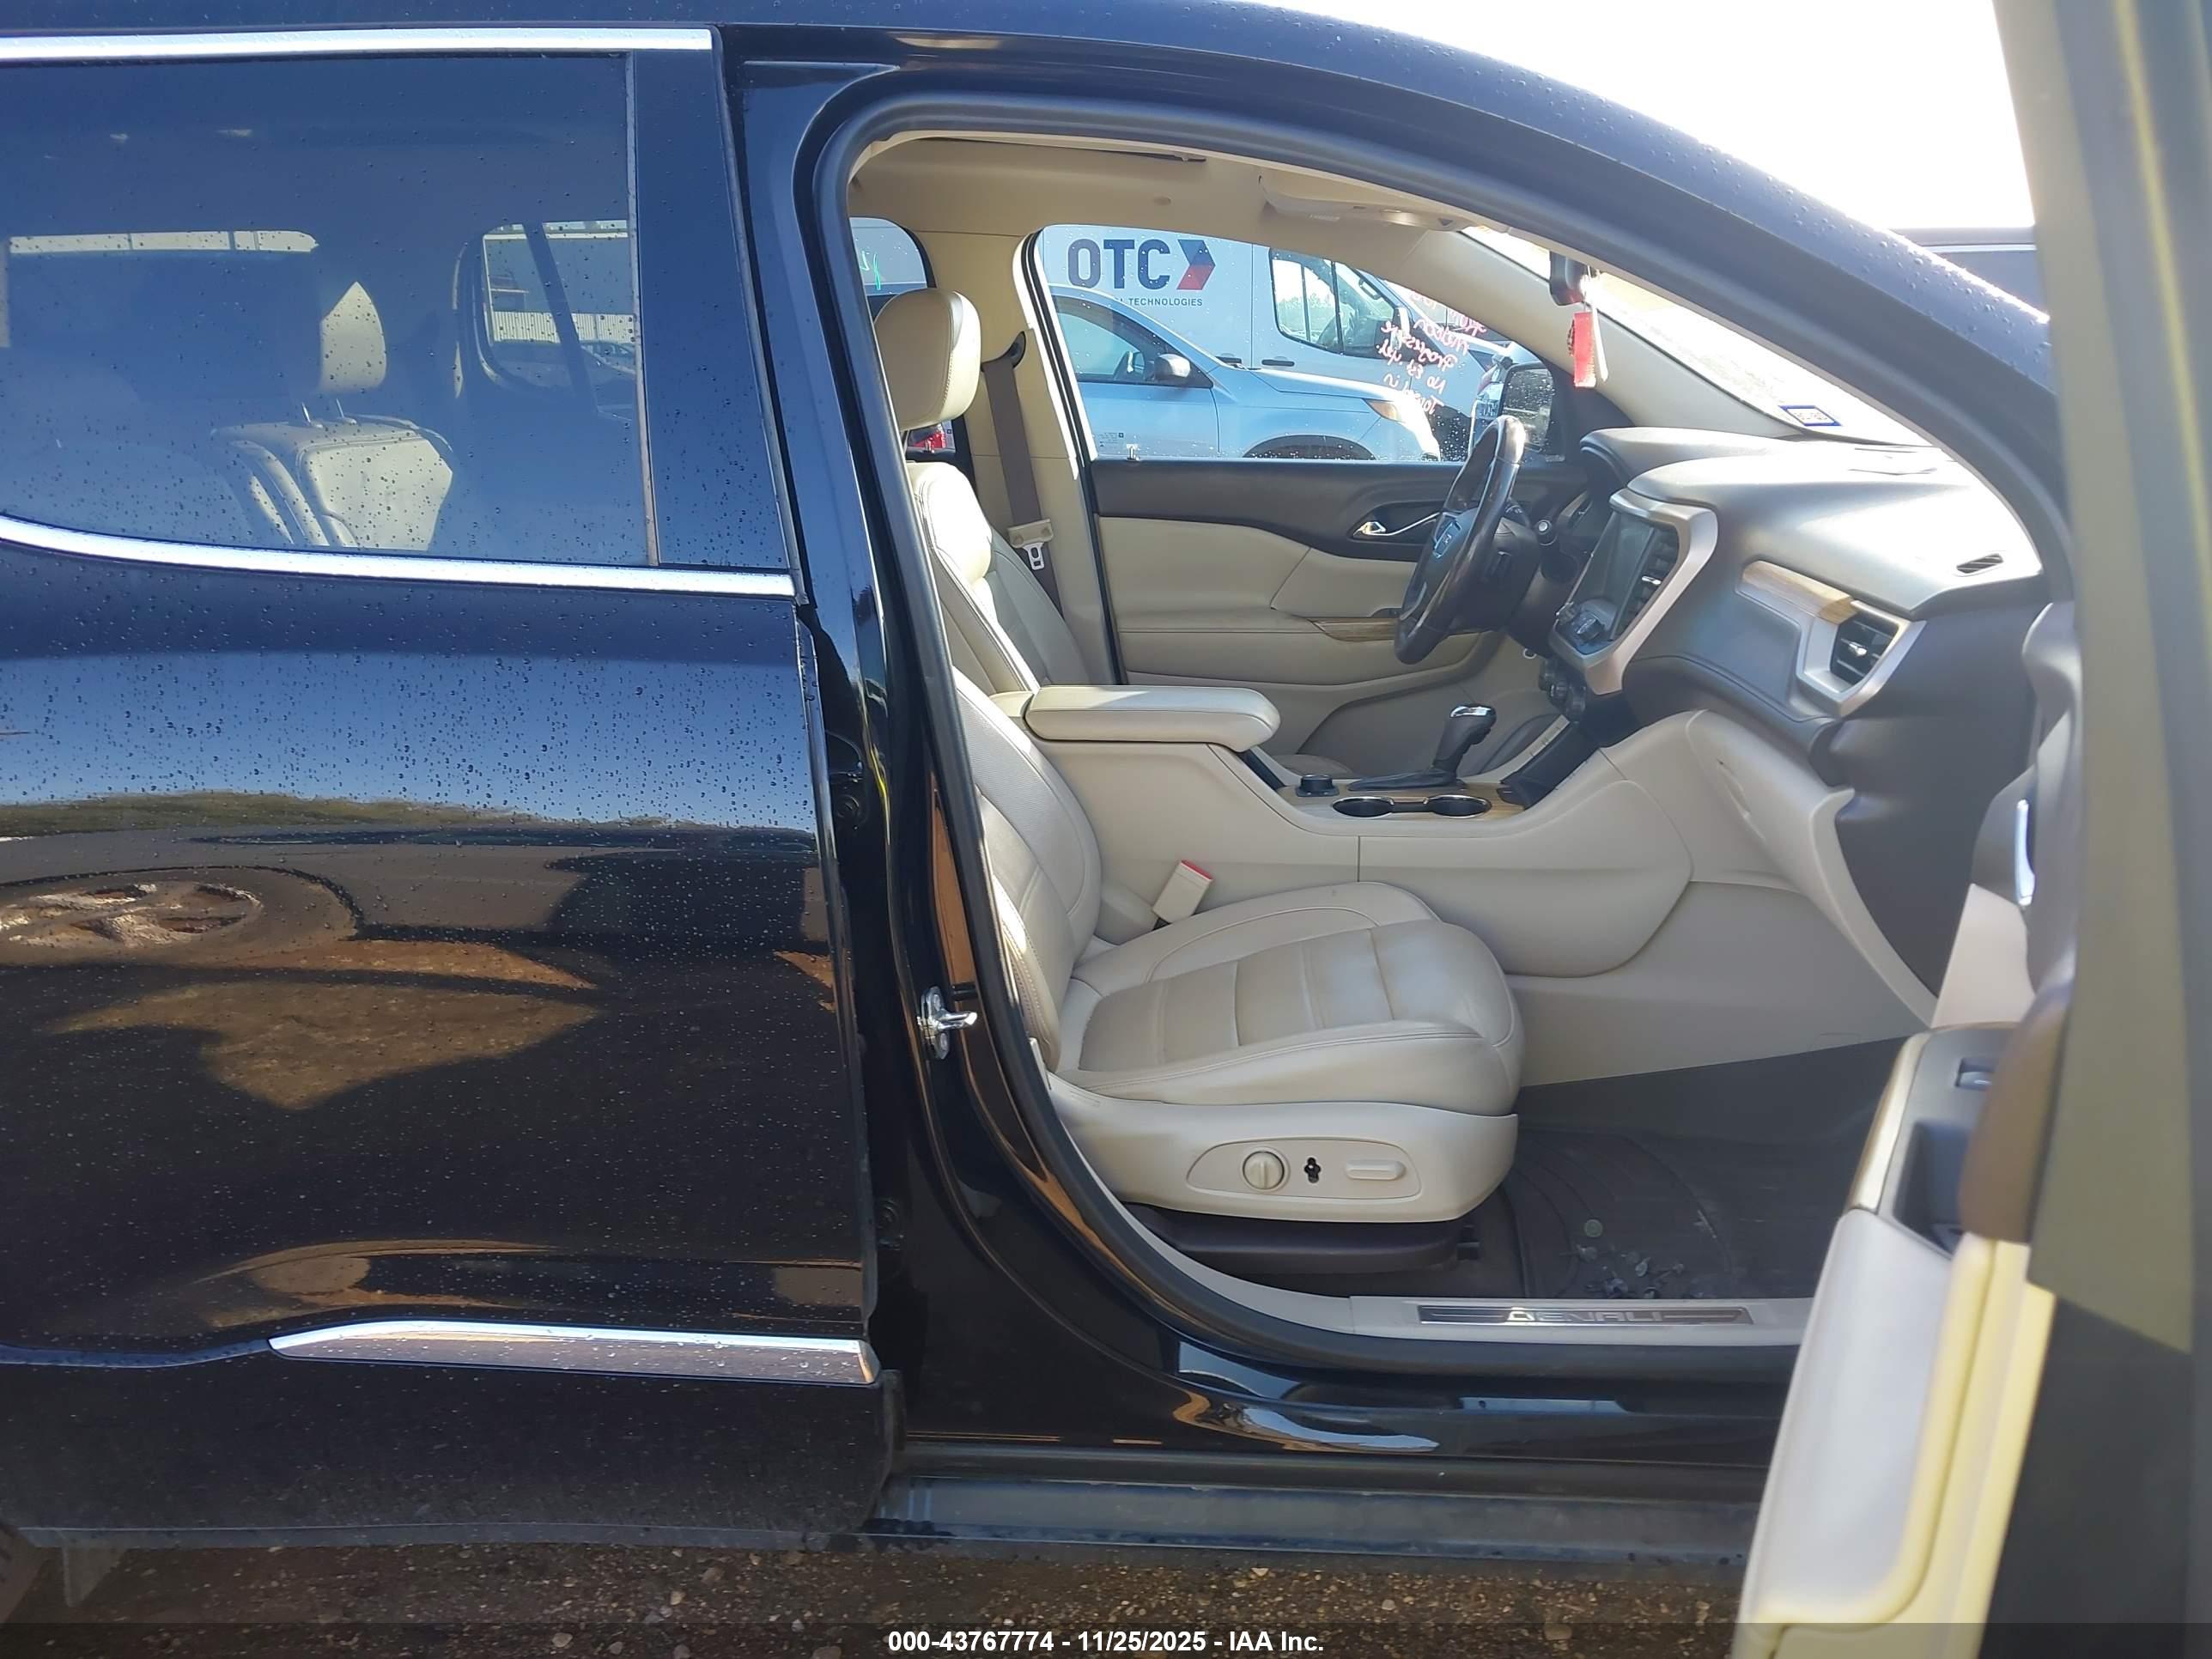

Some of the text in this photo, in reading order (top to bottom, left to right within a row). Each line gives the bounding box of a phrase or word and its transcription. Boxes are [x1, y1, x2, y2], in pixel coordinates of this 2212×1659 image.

[1067, 238, 1170, 290] OTC
[1128, 297, 1203, 307] TECHNOLOGIES
[1507, 1310, 1663, 1322] DENALI
